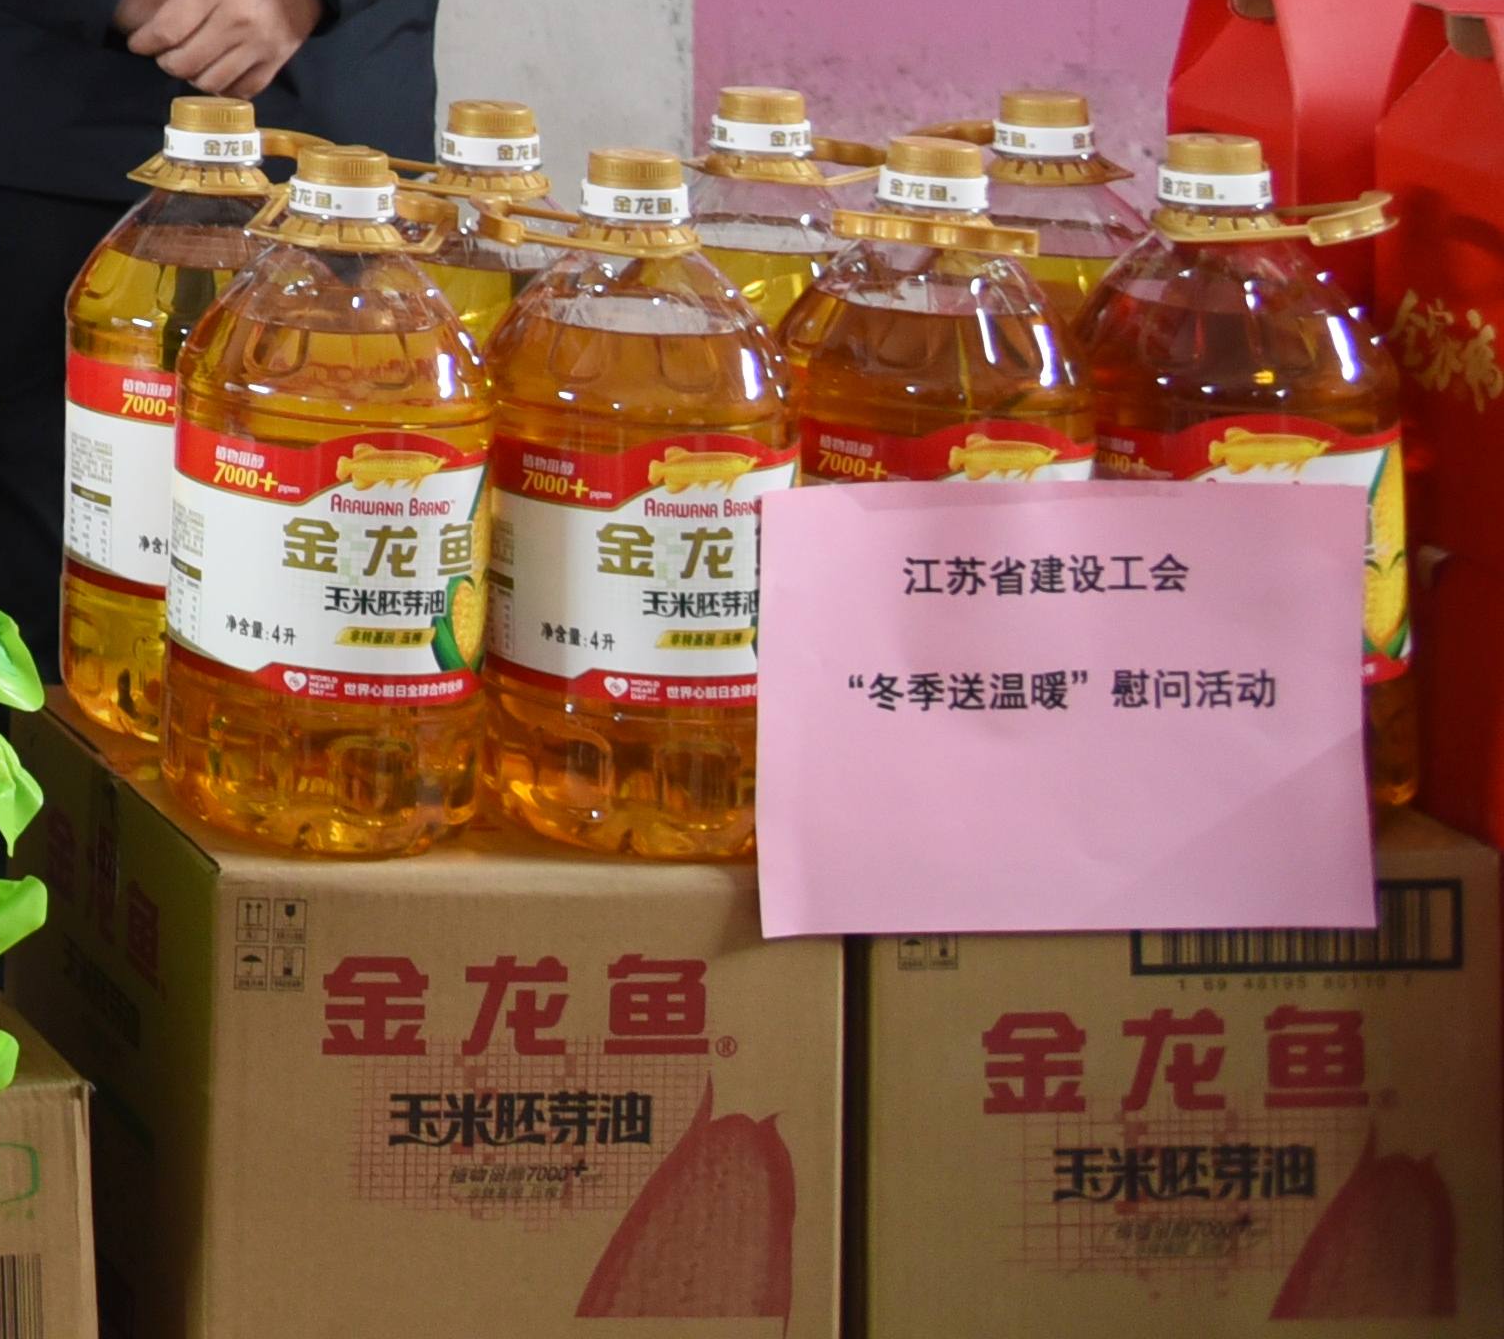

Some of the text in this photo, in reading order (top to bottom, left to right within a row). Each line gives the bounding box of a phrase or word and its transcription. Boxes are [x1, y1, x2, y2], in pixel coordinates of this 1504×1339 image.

[138, 534, 169, 557] 净含
[282, 516, 474, 579] 金龙鱼
[596, 521, 760, 580] 金龙
[903, 554, 1190, 597] 江苏省建设工会
[848, 668, 1278, 712] “冬季送温暖” 慰问活动
[321, 953, 709, 1057] 金龙鱼
[981, 1004, 1371, 1115] 金龙鱼
[389, 1091, 653, 1148] 玉米胚芽油
[1052, 1144, 1317, 1203] 玉米胚芽油
